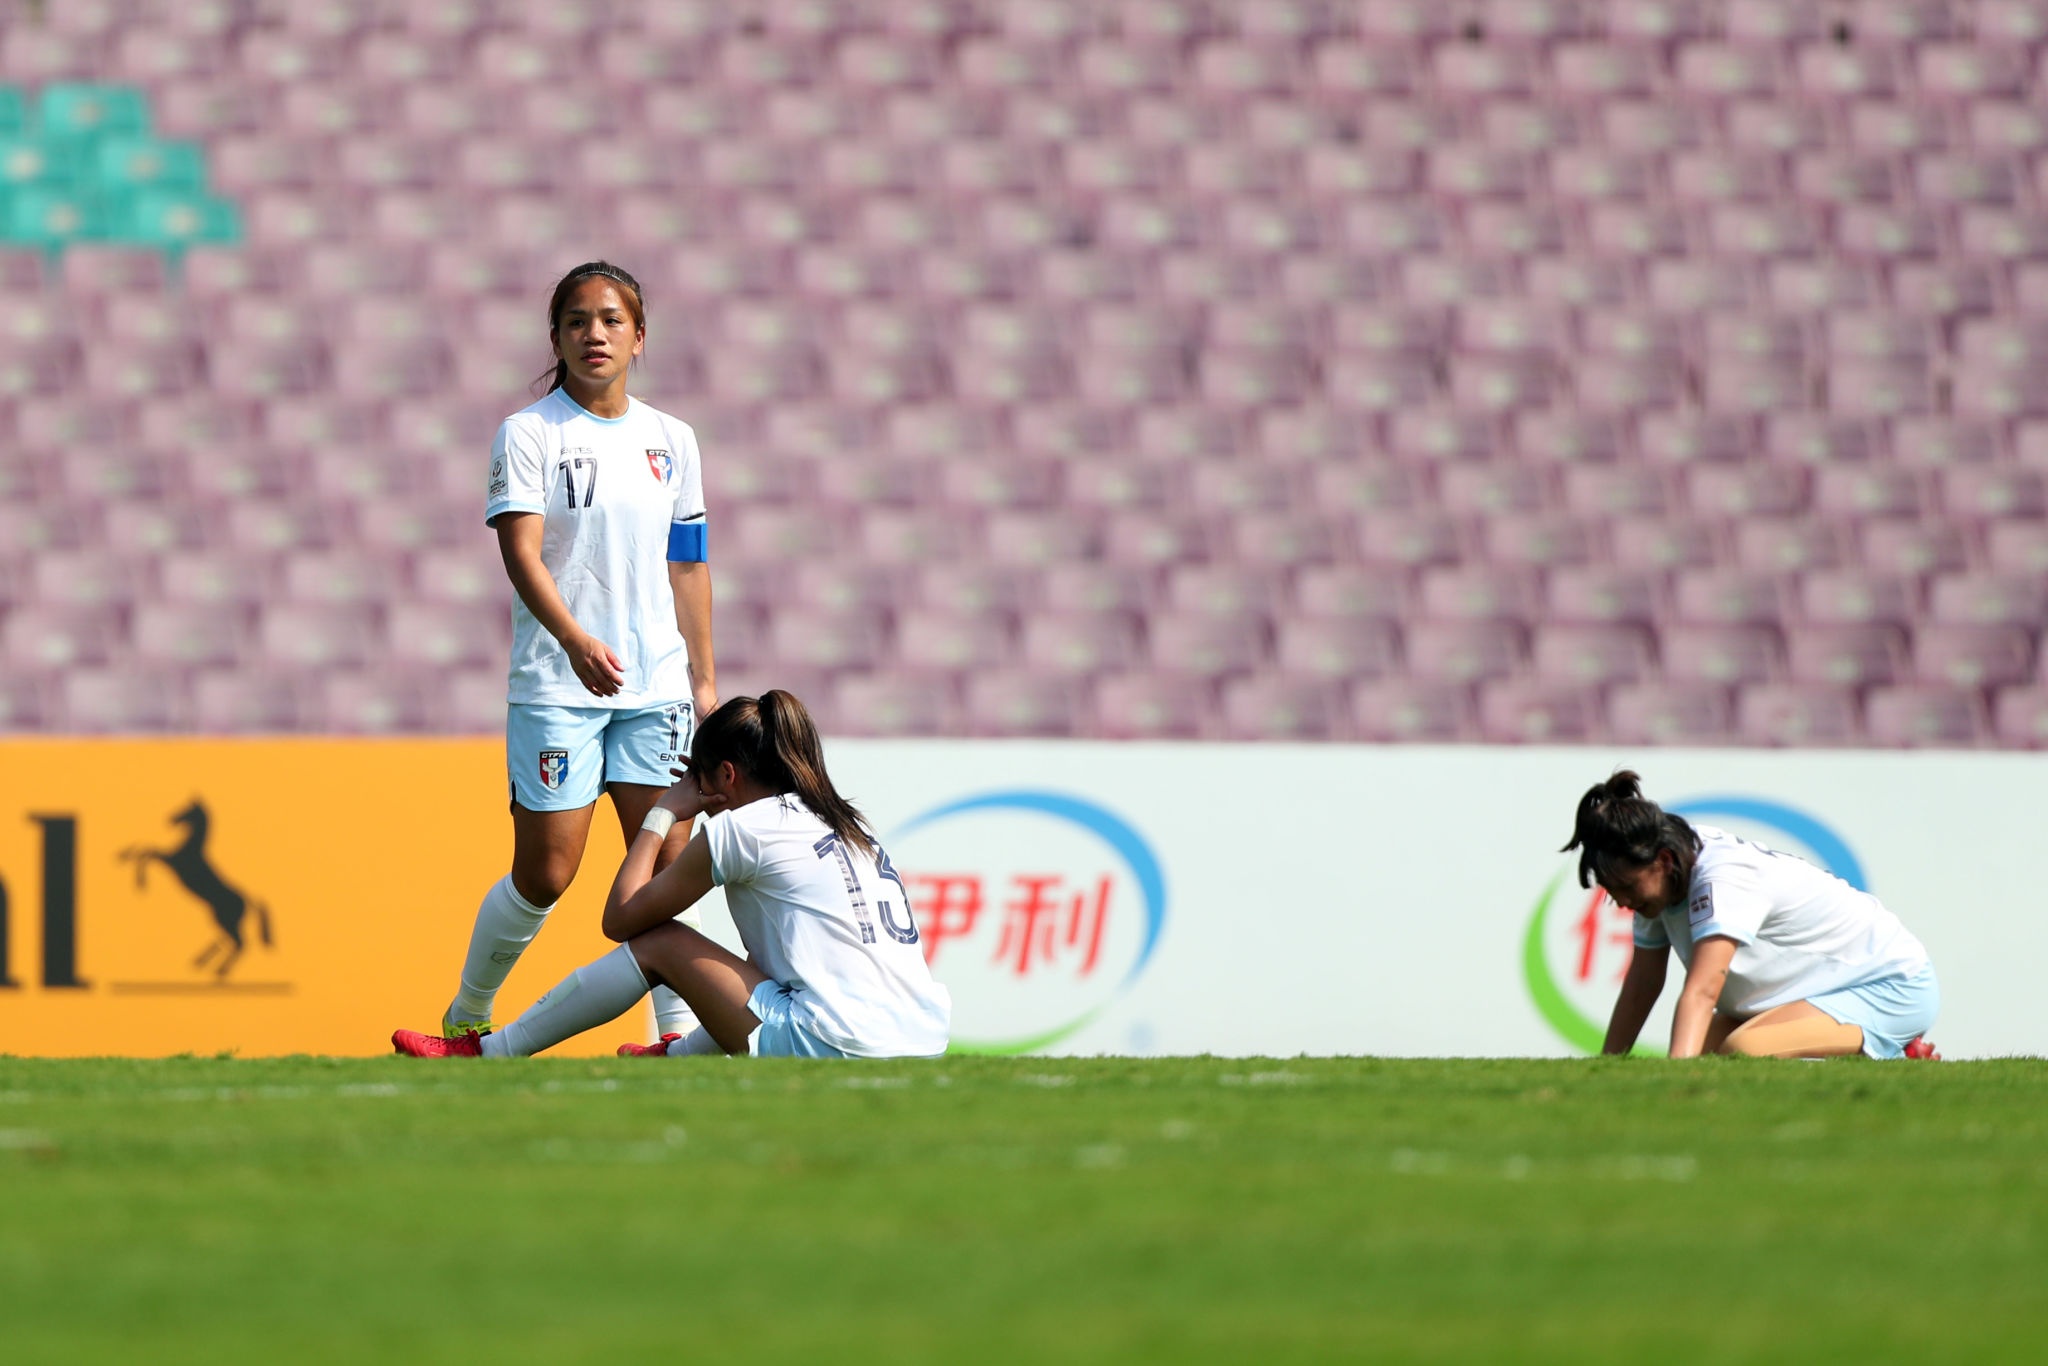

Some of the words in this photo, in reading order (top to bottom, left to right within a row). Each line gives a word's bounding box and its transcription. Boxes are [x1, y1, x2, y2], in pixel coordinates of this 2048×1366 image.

[559, 457, 598, 509] 17
[664, 703, 692, 752] 17
[813, 832, 919, 945] 13
